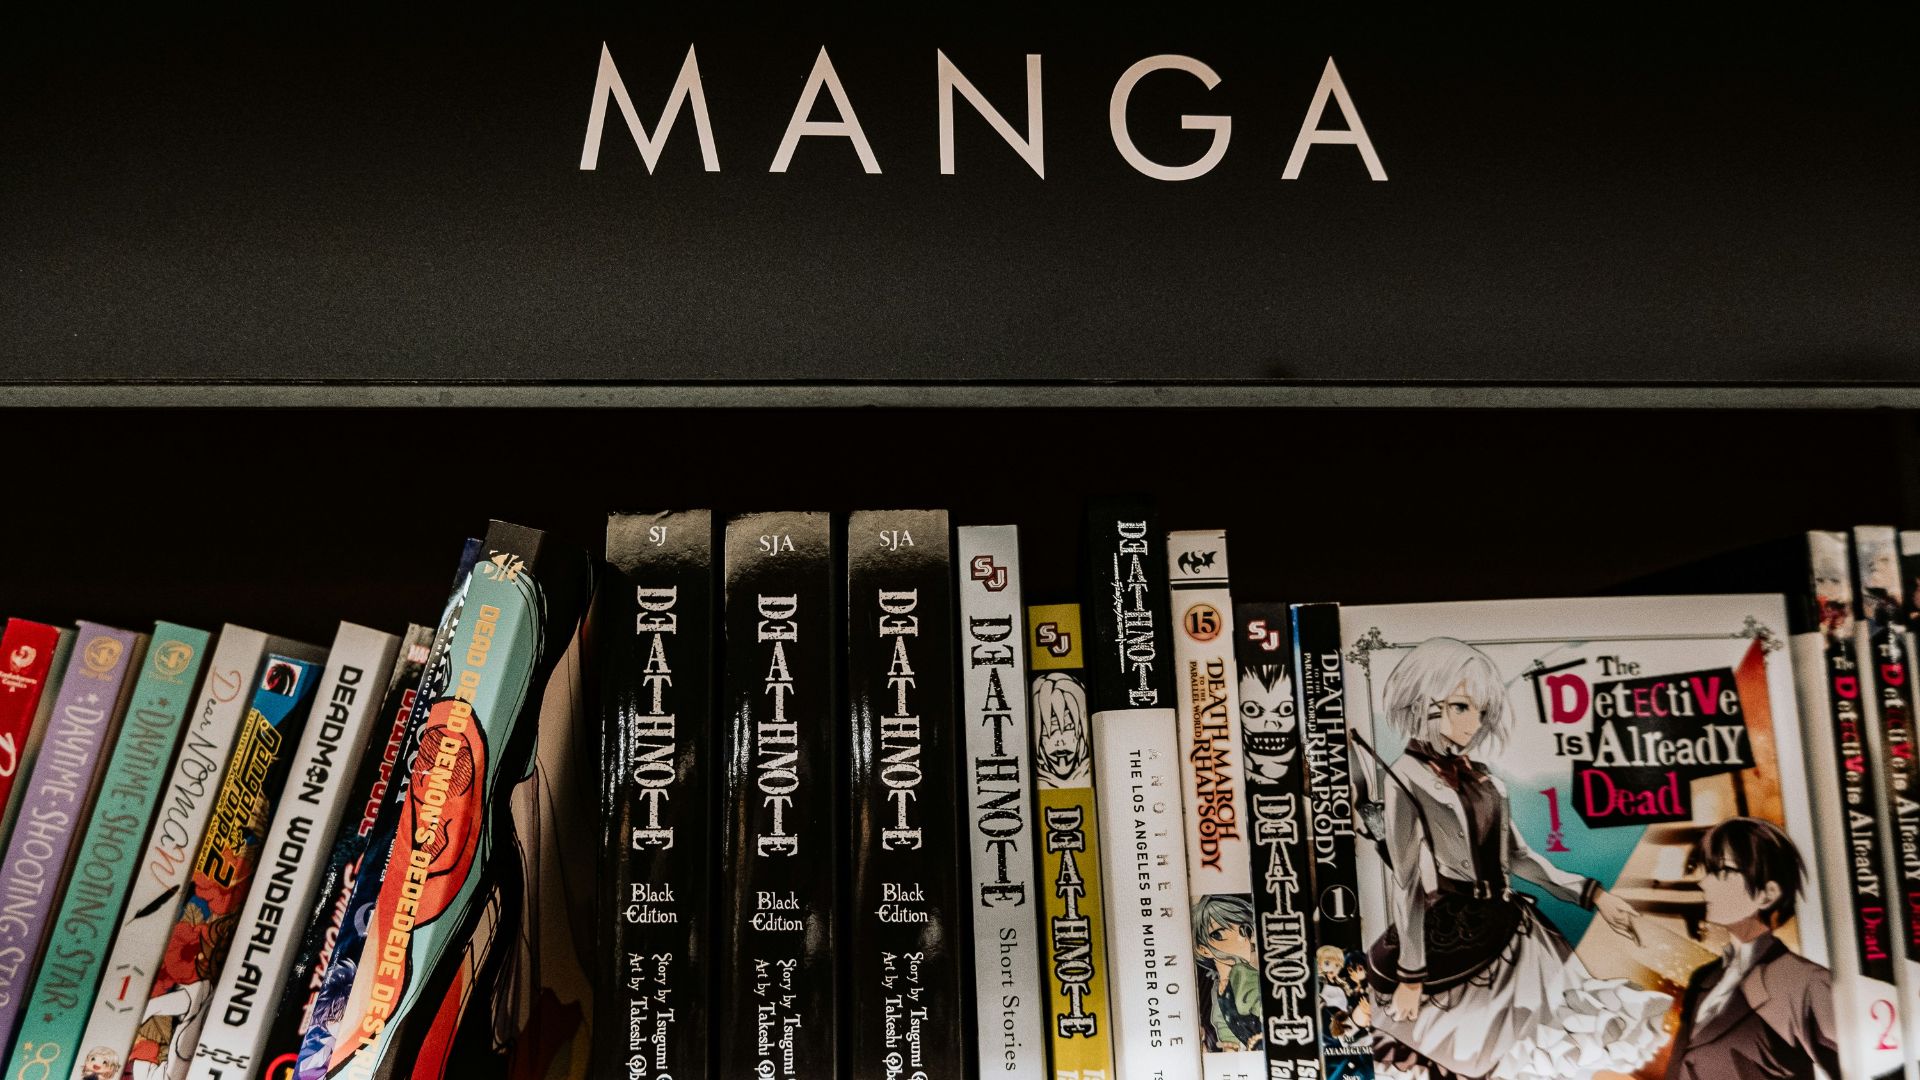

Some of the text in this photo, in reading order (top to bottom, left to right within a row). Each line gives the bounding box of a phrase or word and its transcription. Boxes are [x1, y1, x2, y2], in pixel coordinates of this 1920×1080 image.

[580, 40, 1389, 181] MANGA
[649, 526, 668, 545] SJ
[759, 534, 796, 554] SJA
[879, 529, 915, 547] SJA
[466, 604, 501, 668] DEAD
[1191, 611, 1216, 634] 15
[1596, 655, 1641, 676] The
[200, 666, 242, 731] Dear
[446, 670, 481, 734] DEAD
[1189, 661, 1202, 738] PARALLEL WORLD
[1307, 698, 1317, 732] WORLD
[41, 705, 104, 802] DAYTIME
[111, 709, 176, 806] DAYTIME
[1201, 657, 1240, 841] DEATH MARCH
[1316, 649, 1355, 837] DEATH MARCH
[1554, 733, 1584, 756] Is
[415, 736, 462, 845] DEMON'S
[1190, 739, 1222, 872] RHAPSODY
[1306, 732, 1337, 869] RHAPSODY
[1580, 769, 1686, 817] Dead
[1539, 787, 1571, 852] 1
[0, 807, 69, 938] SHOOTING
[64, 811, 140, 939] SHOOTING
[630, 883, 675, 902] Black
[882, 883, 925, 902] Black
[224, 816, 313, 1027] WONDERLAND
[378, 849, 432, 980] DEDEDEDE
[622, 905, 678, 923] Edition
[748, 913, 803, 931] Edition
[756, 891, 800, 910] Black
[874, 904, 929, 923] Edition
[1130, 750, 1162, 1048] THE LOS ANGELES BB MURDER CASES
[1331, 887, 1347, 918] 1
[42, 944, 96, 1009] STAR
[627, 952, 645, 972] Art
[627, 977, 645, 991] by
[651, 952, 672, 985] Story
[754, 959, 771, 978] Art
[881, 952, 898, 971] Art
[881, 975, 898, 989] by
[903, 952, 923, 983] Story
[118, 975, 131, 1001] 1
[654, 989, 671, 1003] by
[754, 983, 771, 997] by
[907, 987, 924, 1001] by
[1000, 927, 1022, 1071] Short Stories
[1164, 955, 1184, 1047] NOTE
[629, 996, 648, 1050] Takeshi
[651, 1008, 675, 1070] Tsugumi
[758, 1002, 777, 1056] Takeshi
[776, 959, 802, 1075] Story by Tsugumi
[885, 994, 903, 1048] Takeshi
[906, 1006, 928, 1068] Tsugumi
[1870, 999, 1898, 1050] 2
